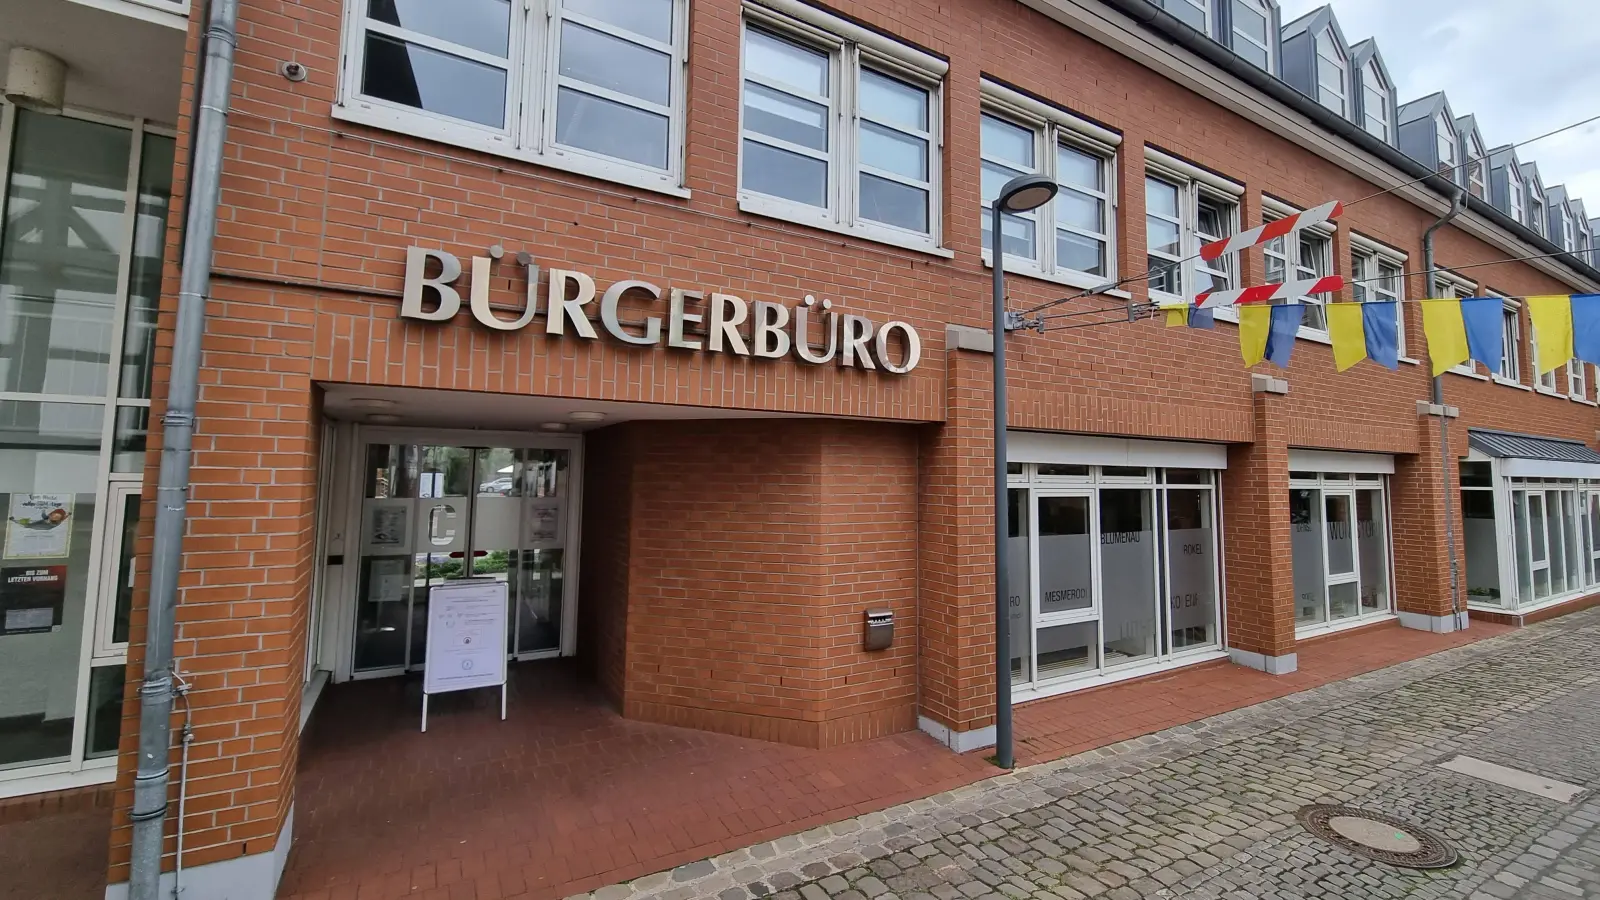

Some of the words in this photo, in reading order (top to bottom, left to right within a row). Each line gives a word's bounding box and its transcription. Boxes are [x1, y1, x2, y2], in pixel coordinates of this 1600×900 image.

[400, 244, 922, 374] BÜRGERBÜRO
[428, 504, 456, 546] C
[1100, 531, 1141, 545] BLUMENAU
